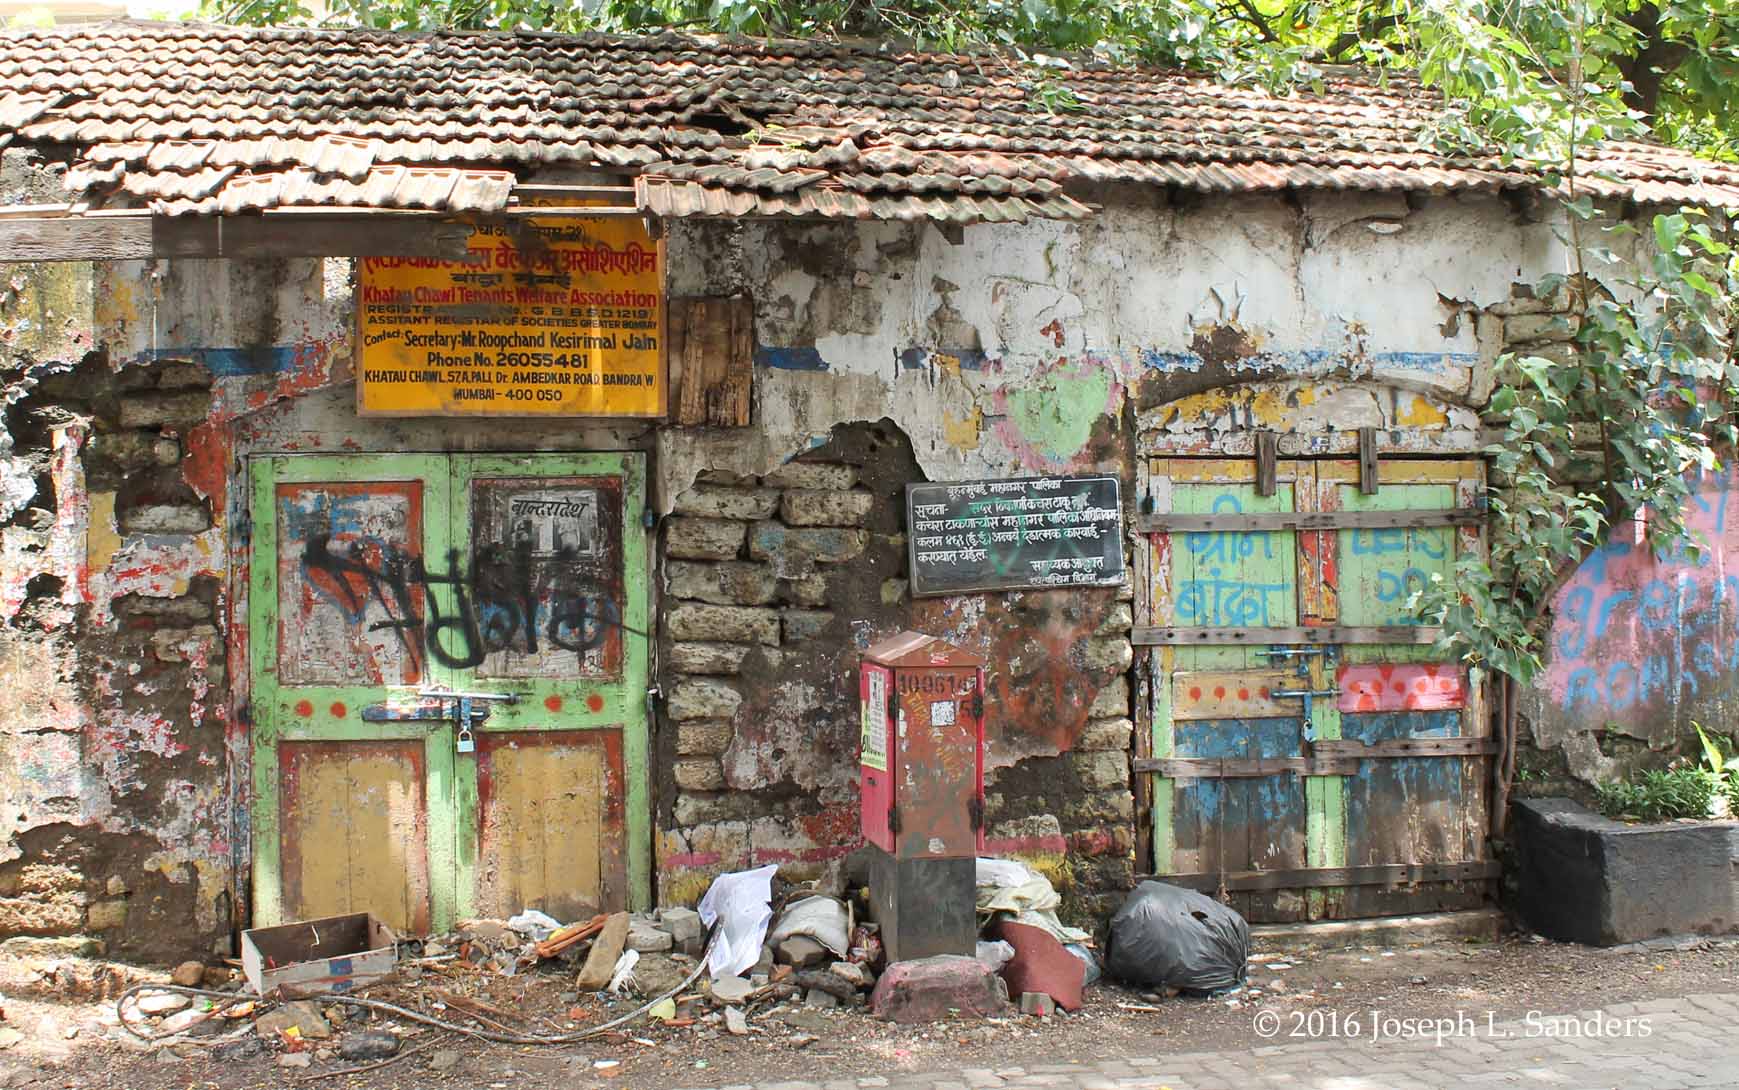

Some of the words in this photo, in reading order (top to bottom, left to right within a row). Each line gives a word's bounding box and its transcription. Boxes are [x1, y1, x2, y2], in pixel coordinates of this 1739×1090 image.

[415, 286, 455, 304] Chawl
[456, 287, 514, 305] Tenants
[516, 288, 568, 306] Welfare
[570, 289, 657, 308] Association
[368, 315, 432, 325] ASSITANT
[504, 317, 519, 327] OF
[521, 317, 578, 328] SOCIETIES
[580, 319, 620, 329] GREATER
[478, 331, 545, 350] Roopchand
[550, 332, 616, 349] Kesirimal
[622, 333, 657, 350] Jain
[427, 352, 472, 367] Phone
[474, 352, 494, 367] No.
[496, 353, 588, 369] 26055481
[364, 370, 407, 383] KHATAU
[511, 372, 571, 385] AMBEDKAR
[602, 374, 642, 387] BANDRA
[504, 388, 533, 401] 400
[536, 389, 562, 401] 050
[916, 535, 944, 549] कलम
